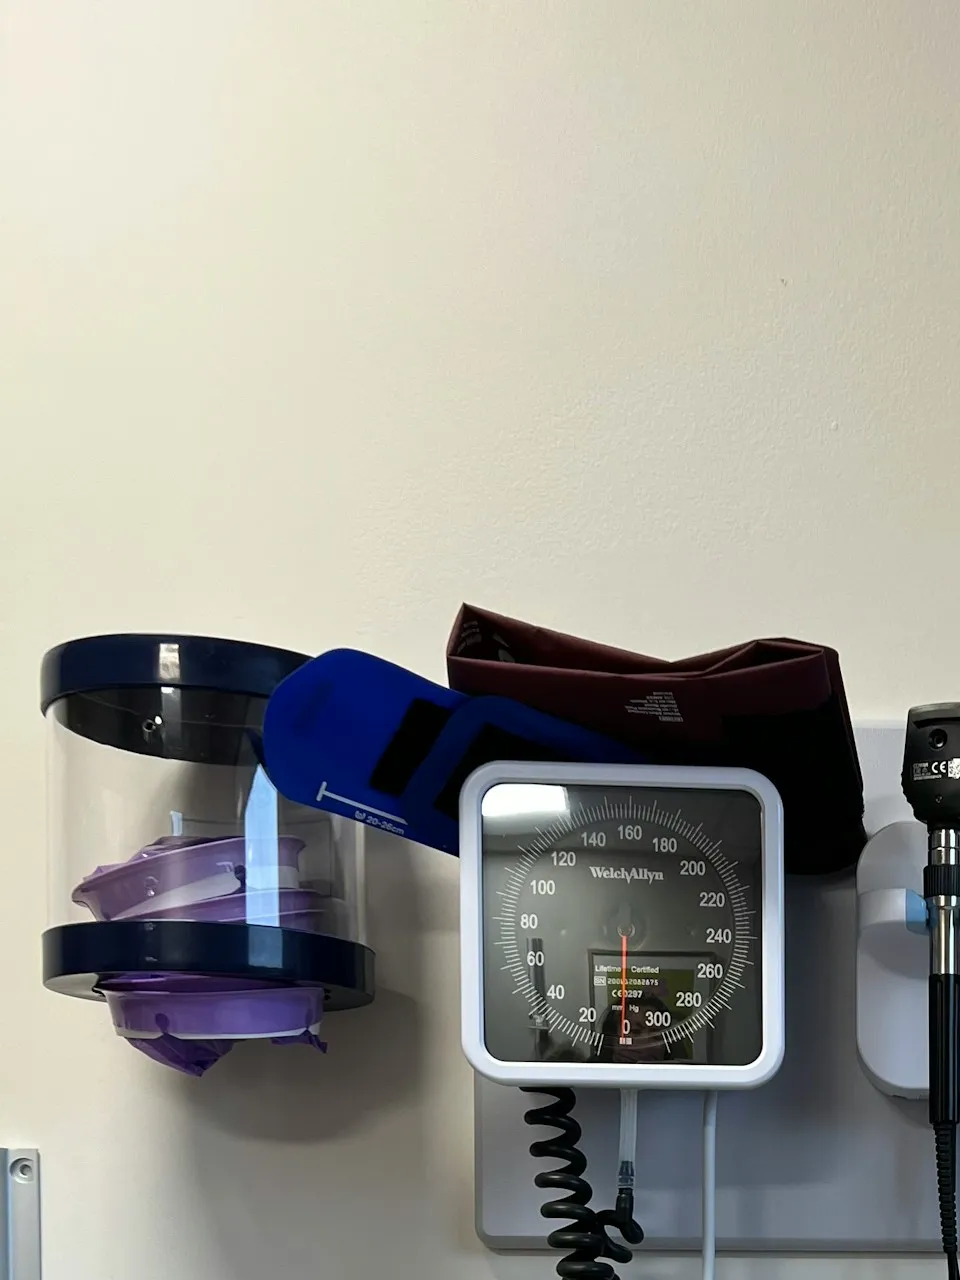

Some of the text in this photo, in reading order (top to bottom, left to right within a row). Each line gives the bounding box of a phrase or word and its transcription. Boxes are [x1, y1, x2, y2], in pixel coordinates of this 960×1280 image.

[581, 832, 606, 847] 140
[617, 825, 642, 840] 160
[652, 837, 677, 852] 180
[551, 852, 576, 866] 120
[589, 866, 664, 884] WelchAllyn
[680, 860, 706, 876] 200
[530, 880, 555, 895] 100
[699, 892, 725, 908] 220
[520, 914, 538, 929] 80
[706, 928, 732, 944] 240
[527, 951, 544, 966] 60
[631, 965, 659, 974] Certified
[697, 963, 722, 979] 260
[547, 984, 564, 1000] 40
[676, 992, 702, 1008] 280
[579, 1008, 596, 1022] 20
[645, 1011, 671, 1026] 300
[622, 1019, 630, 1034] 0
